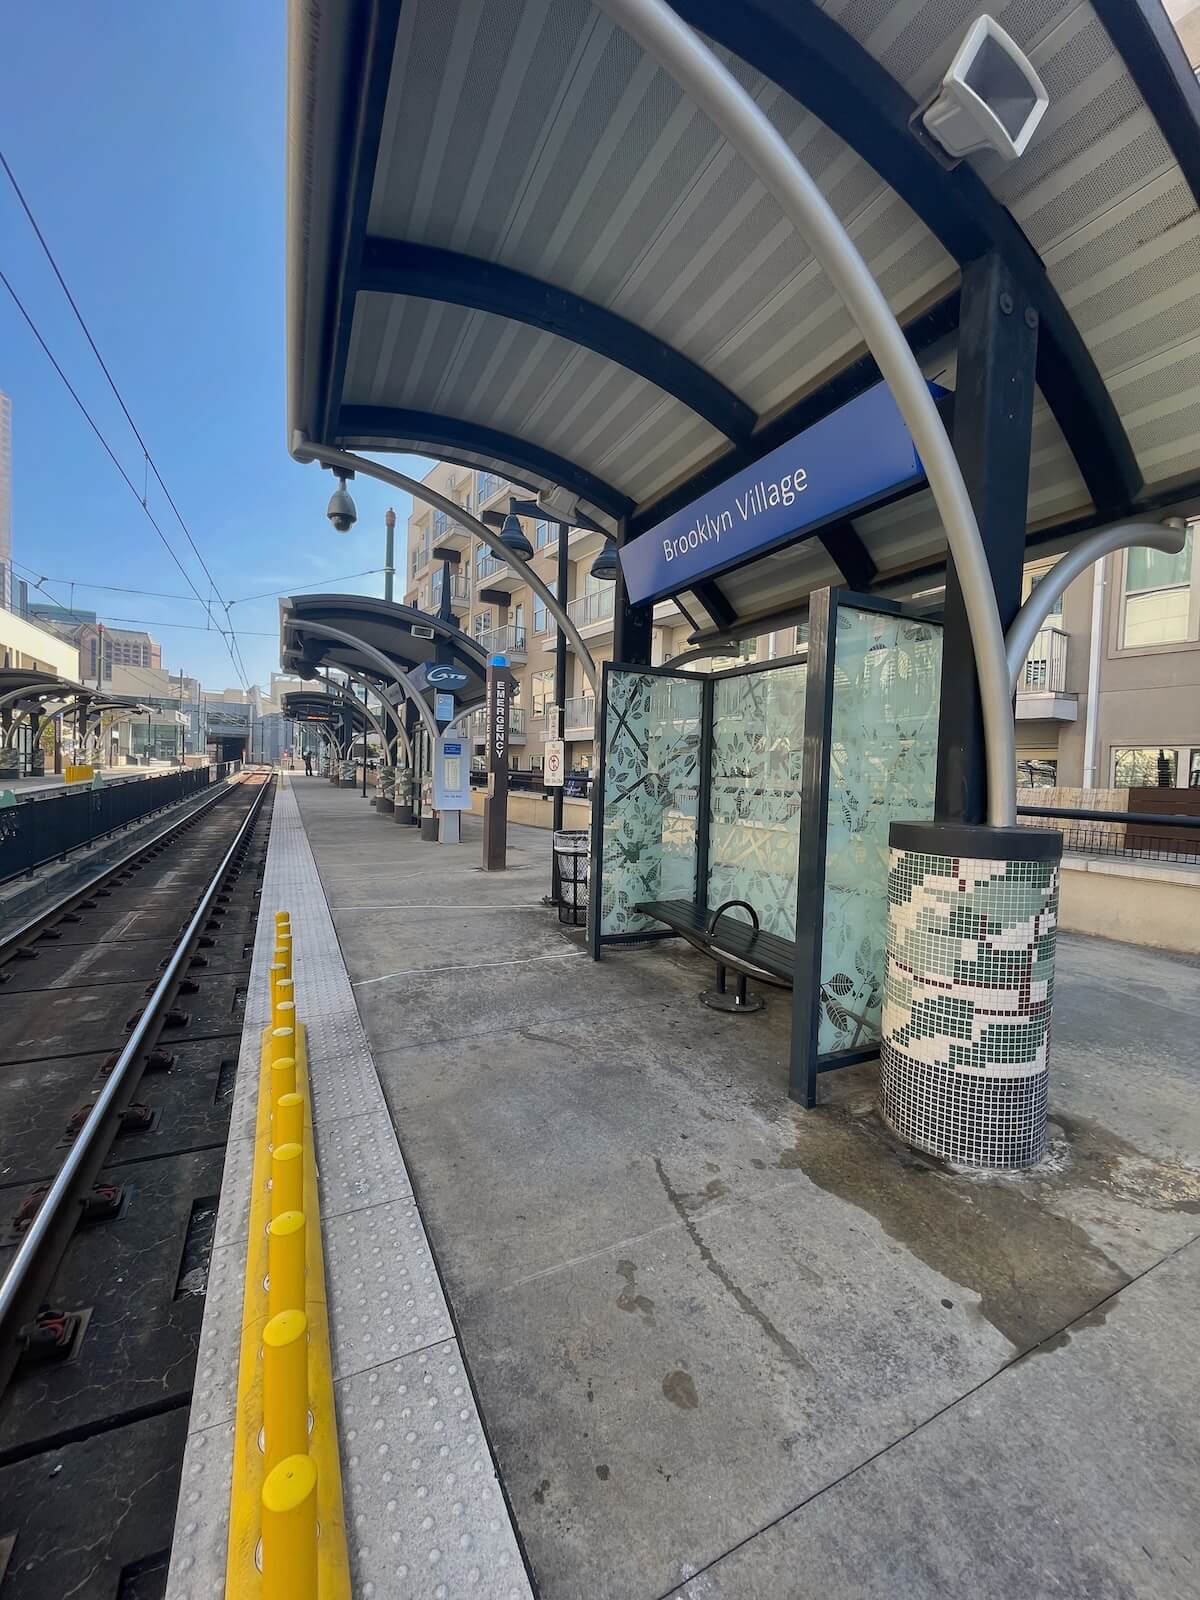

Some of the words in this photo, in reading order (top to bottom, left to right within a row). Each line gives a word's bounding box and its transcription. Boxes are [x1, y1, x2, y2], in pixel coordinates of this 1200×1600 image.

[663, 510, 732, 562] Brooklyn
[736, 467, 808, 522] Village
[495, 681, 505, 758] EMERGENCY
